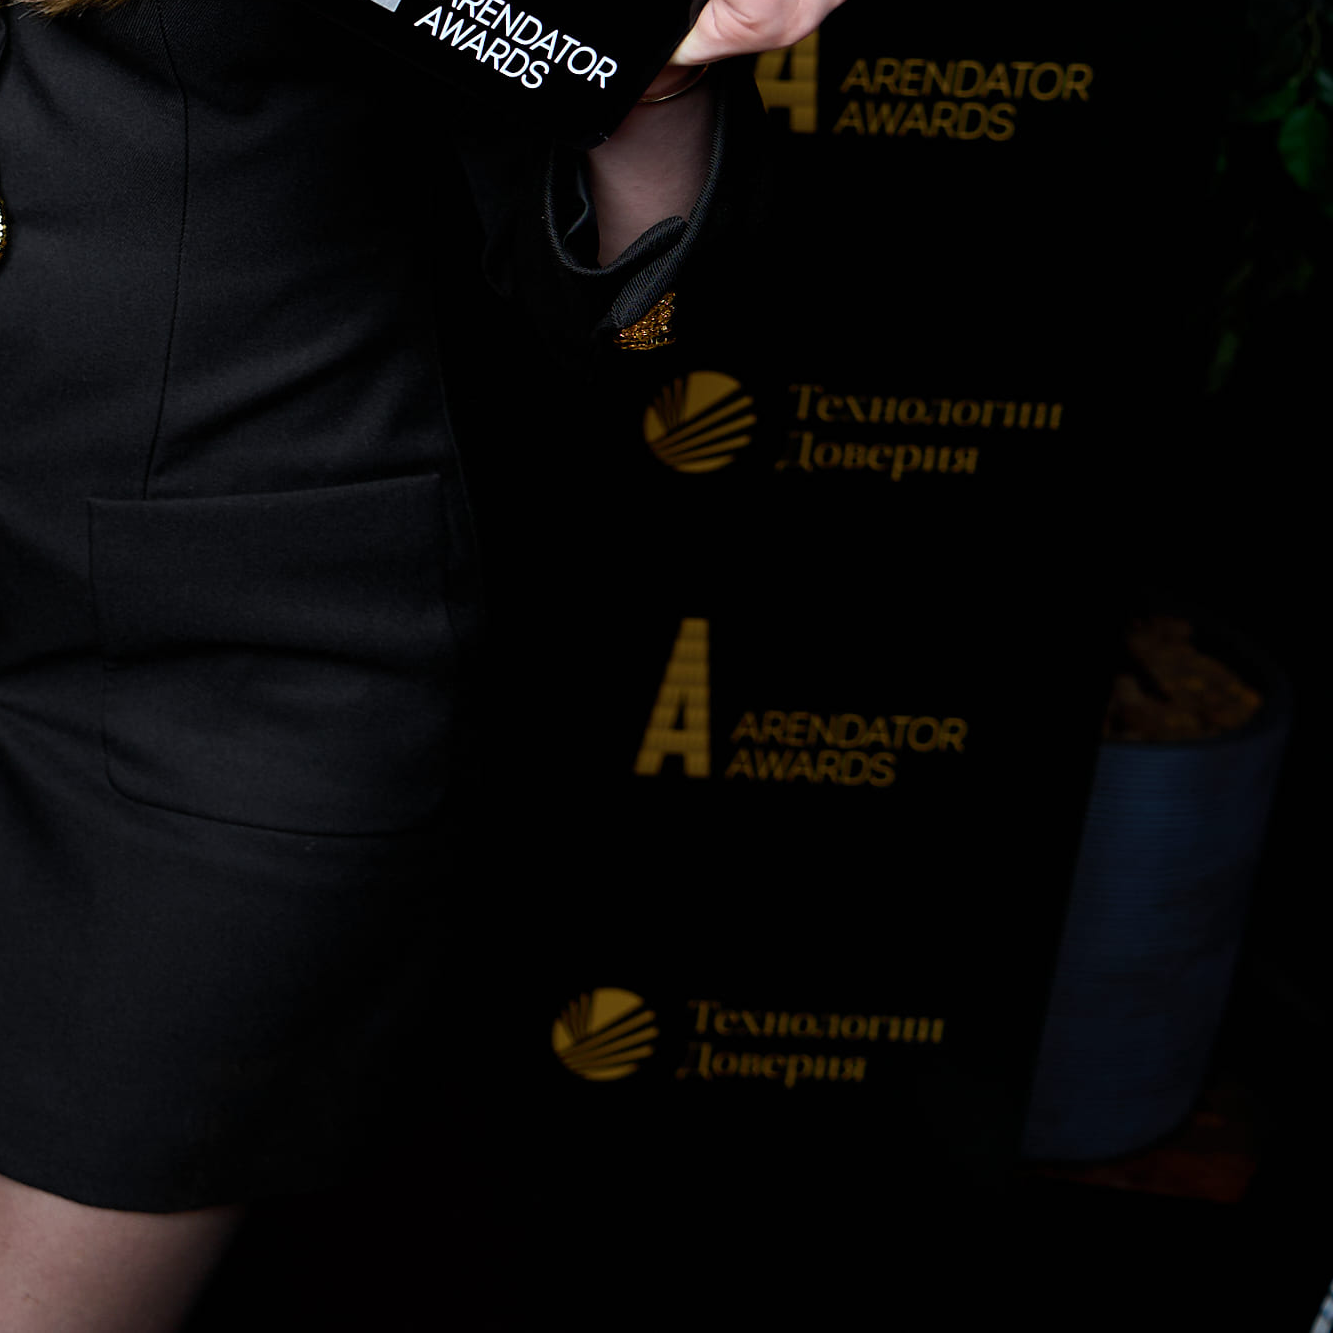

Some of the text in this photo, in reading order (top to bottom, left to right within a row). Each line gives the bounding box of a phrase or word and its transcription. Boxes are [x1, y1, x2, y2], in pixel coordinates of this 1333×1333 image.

[414, 6, 550, 90] AWARDS
[840, 58, 1094, 102] ARENDATOR
[832, 100, 1017, 141] AWARDS
[789, 383, 1064, 430] Технологии
[775, 431, 980, 482] Доверия
[730, 710, 969, 753] ARENDATOR
[725, 748, 898, 787] AWARDS
[686, 999, 946, 1044] Технологии
[674, 1041, 868, 1089] Доверия
